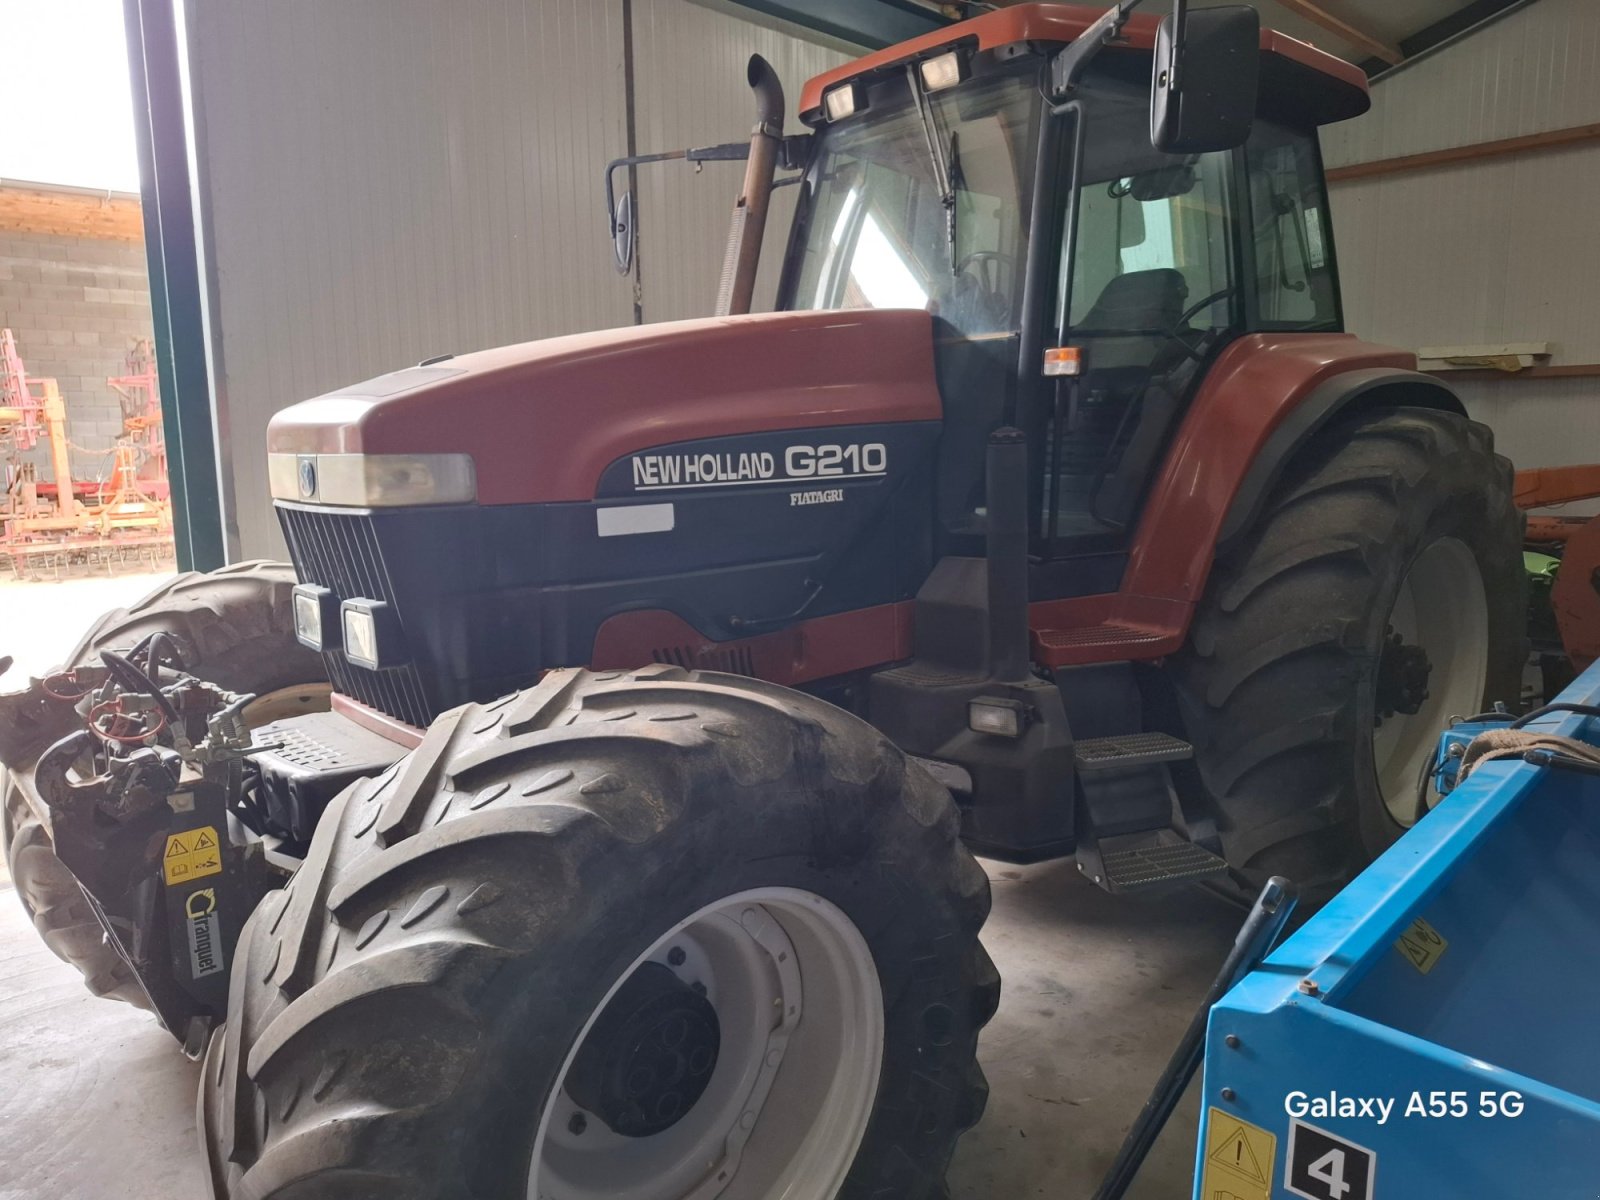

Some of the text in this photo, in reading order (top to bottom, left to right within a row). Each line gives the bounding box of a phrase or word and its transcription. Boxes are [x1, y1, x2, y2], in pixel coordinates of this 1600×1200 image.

[632, 443, 887, 485] NEW HOLLAND G210
[790, 489, 844, 506] FIATAGRI
[1307, 1148, 1350, 1200] 4
